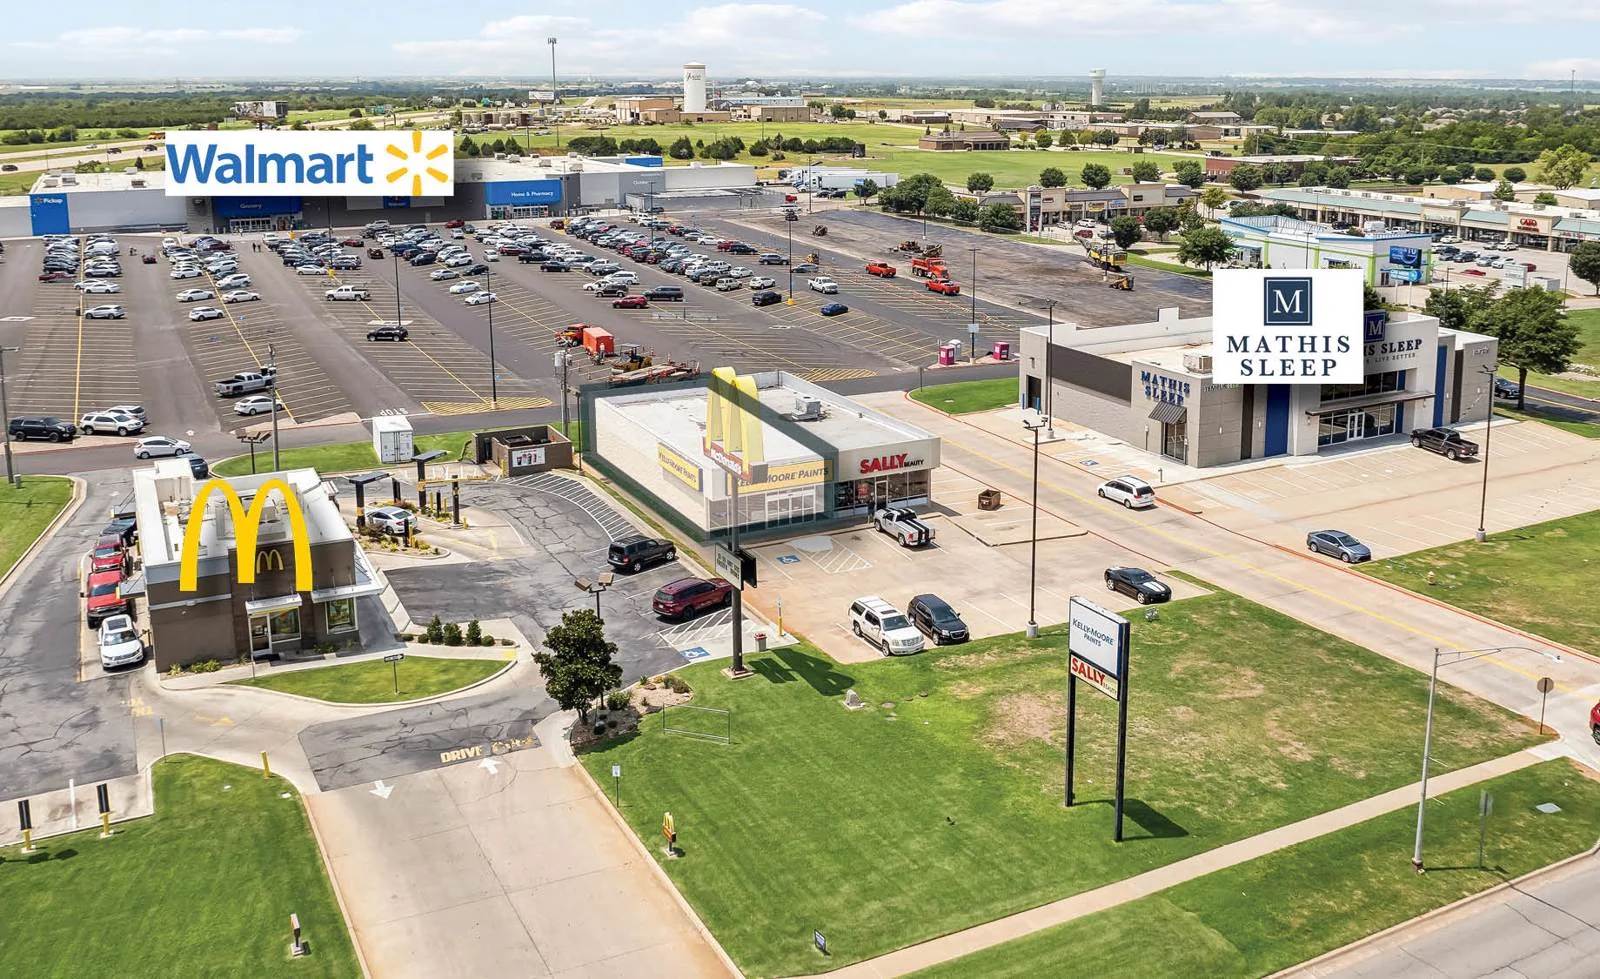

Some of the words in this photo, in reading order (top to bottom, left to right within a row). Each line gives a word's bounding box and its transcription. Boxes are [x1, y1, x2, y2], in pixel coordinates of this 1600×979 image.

[1368, 320, 1383, 336] M
[1381, 339, 1422, 354] SLEEP
[1141, 371, 1190, 394] MATHIS
[1145, 385, 1184, 405] SLEEP
[798, 467, 829, 478] PAINTS
[860, 453, 908, 474] SALLY
[904, 459, 925, 467] BEAUTY
[1072, 618, 1115, 646] KELLY-MOORE
[1083, 633, 1103, 647] PAINTS
[1071, 657, 1107, 686] SALLY
